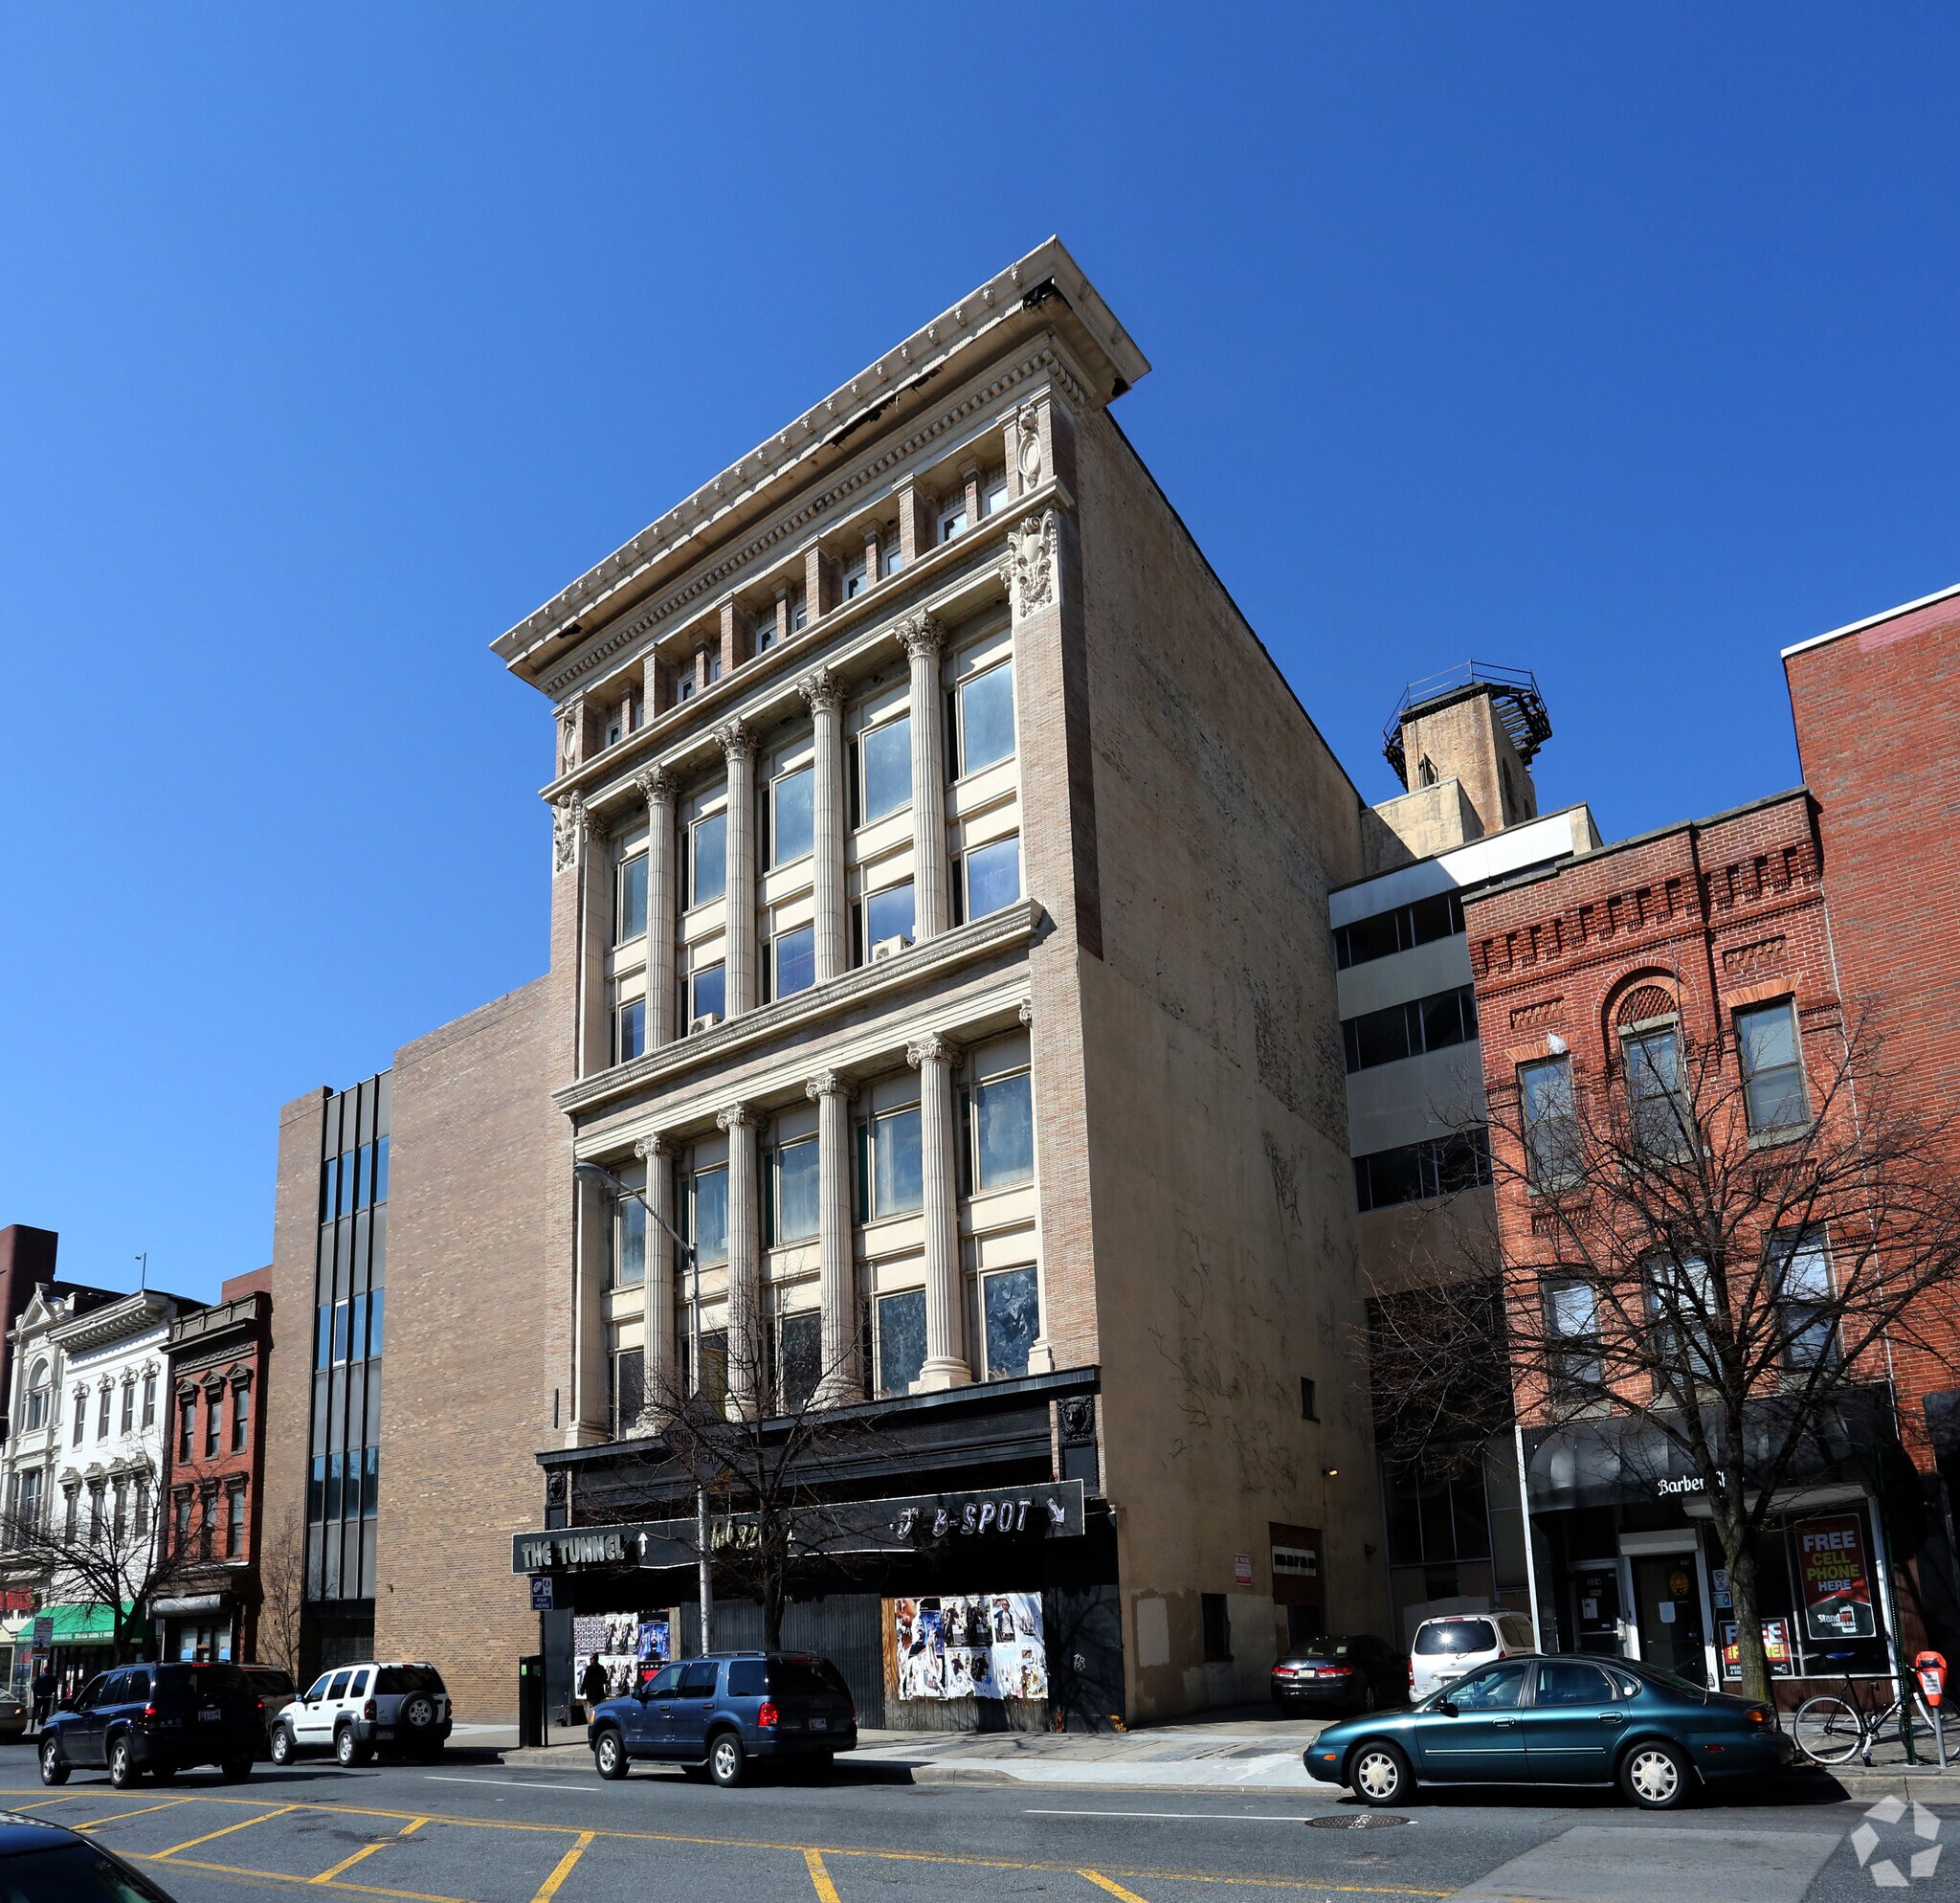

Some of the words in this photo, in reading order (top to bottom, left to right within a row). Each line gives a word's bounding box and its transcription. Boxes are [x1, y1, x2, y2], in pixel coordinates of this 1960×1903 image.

[1657, 1474, 1705, 1496] Barber
[521, 1540, 552, 1568] THE
[558, 1534, 625, 1565] TUNNEL
[1802, 1530, 1857, 1553] FREE
[1812, 1550, 1852, 1567] CELL
[1806, 1564, 1860, 1581] PHONE
[1817, 1578, 1852, 1592] HERE
